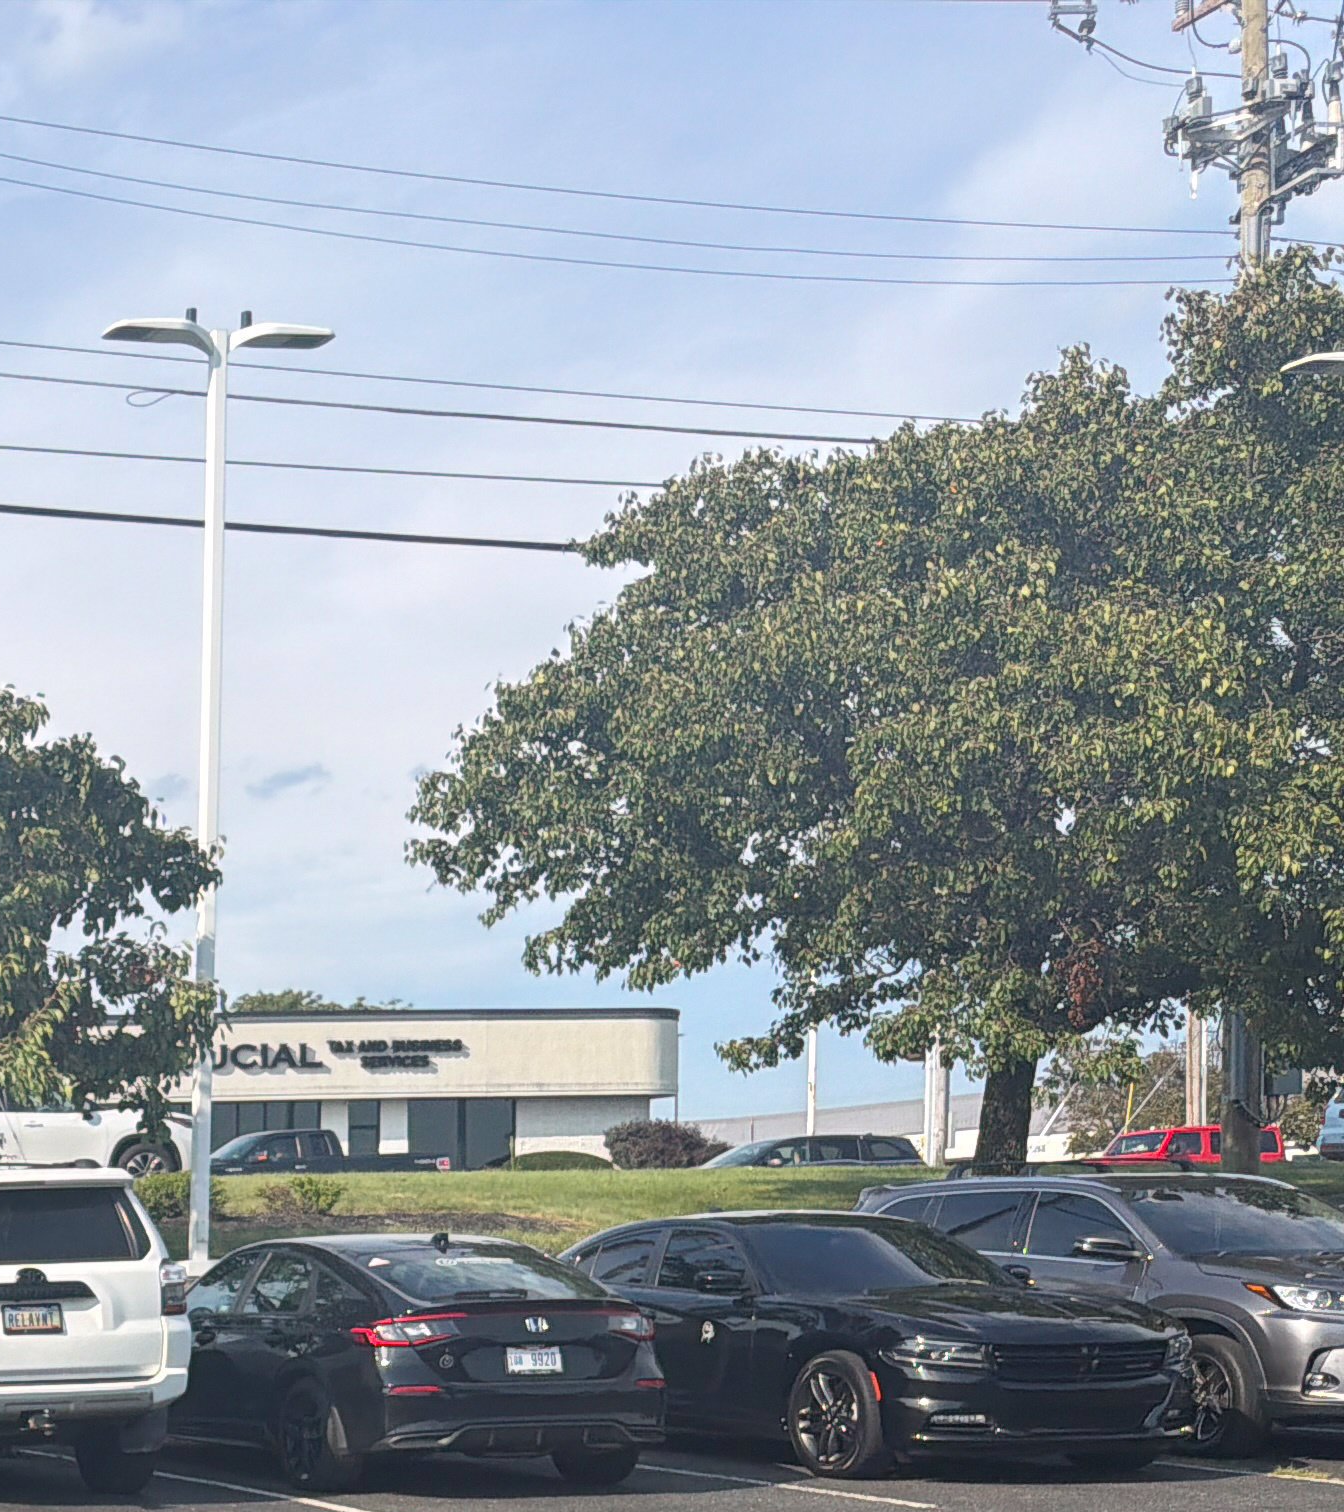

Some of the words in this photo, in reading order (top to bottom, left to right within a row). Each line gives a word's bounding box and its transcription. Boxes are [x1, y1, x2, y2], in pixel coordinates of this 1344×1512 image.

[326, 1040, 354, 1054] TAX
[357, 1040, 389, 1054] AND
[360, 1054, 430, 1069] SERVICES
[531, 1351, 557, 1367] 9920
